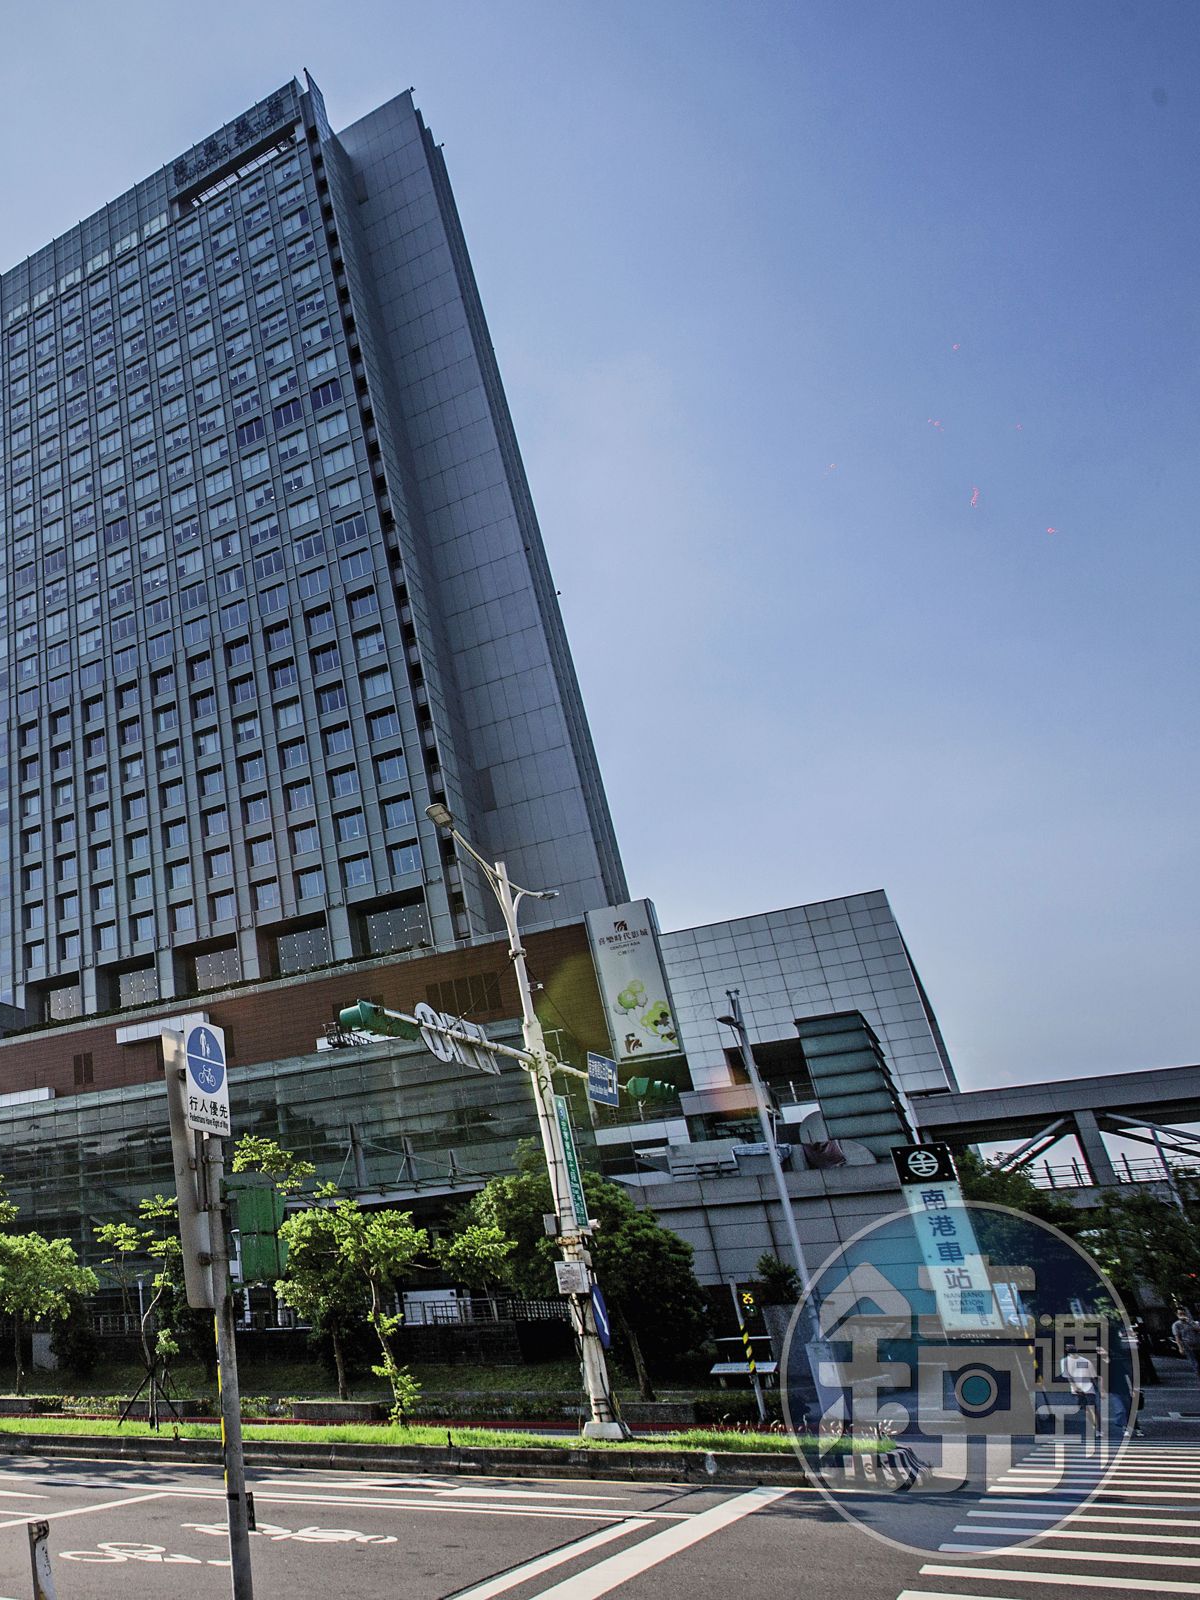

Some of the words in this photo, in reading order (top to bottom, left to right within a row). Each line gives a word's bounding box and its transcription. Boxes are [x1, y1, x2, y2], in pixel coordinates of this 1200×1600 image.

[189, 1095, 228, 1119] 行人優先
[920, 1189, 973, 1289] 南港車站
